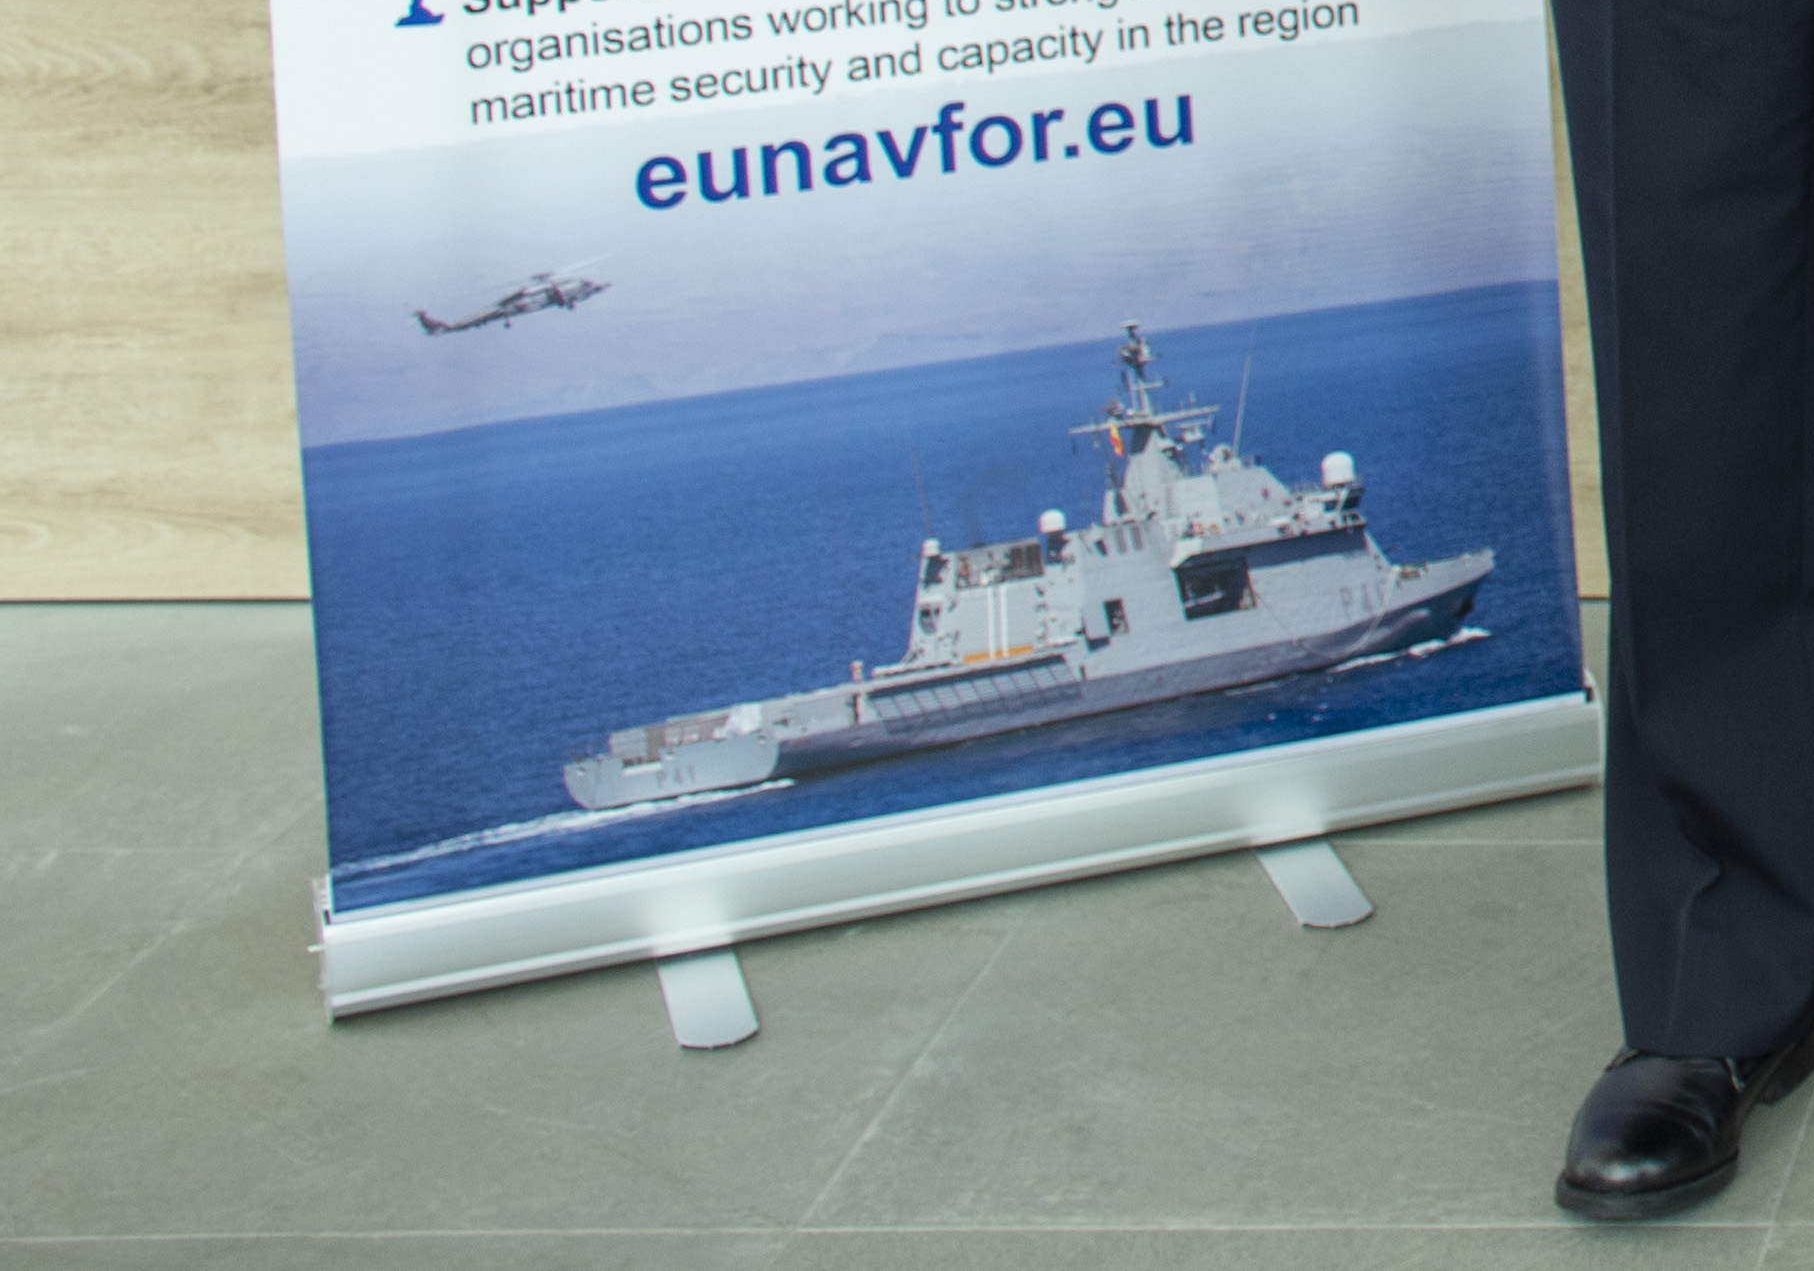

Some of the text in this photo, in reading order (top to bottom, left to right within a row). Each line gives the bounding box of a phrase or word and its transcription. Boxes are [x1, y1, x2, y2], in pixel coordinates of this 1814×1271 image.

[466, 14, 753, 73] organisations
[471, 79, 656, 125] maritime
[669, 56, 833, 103] security
[847, 41, 922, 82] and
[937, 25, 1104, 75] capacity
[1117, 19, 1150, 51] in
[1164, 12, 1225, 46] the
[634, 94, 1195, 210] eunavfor.eu
